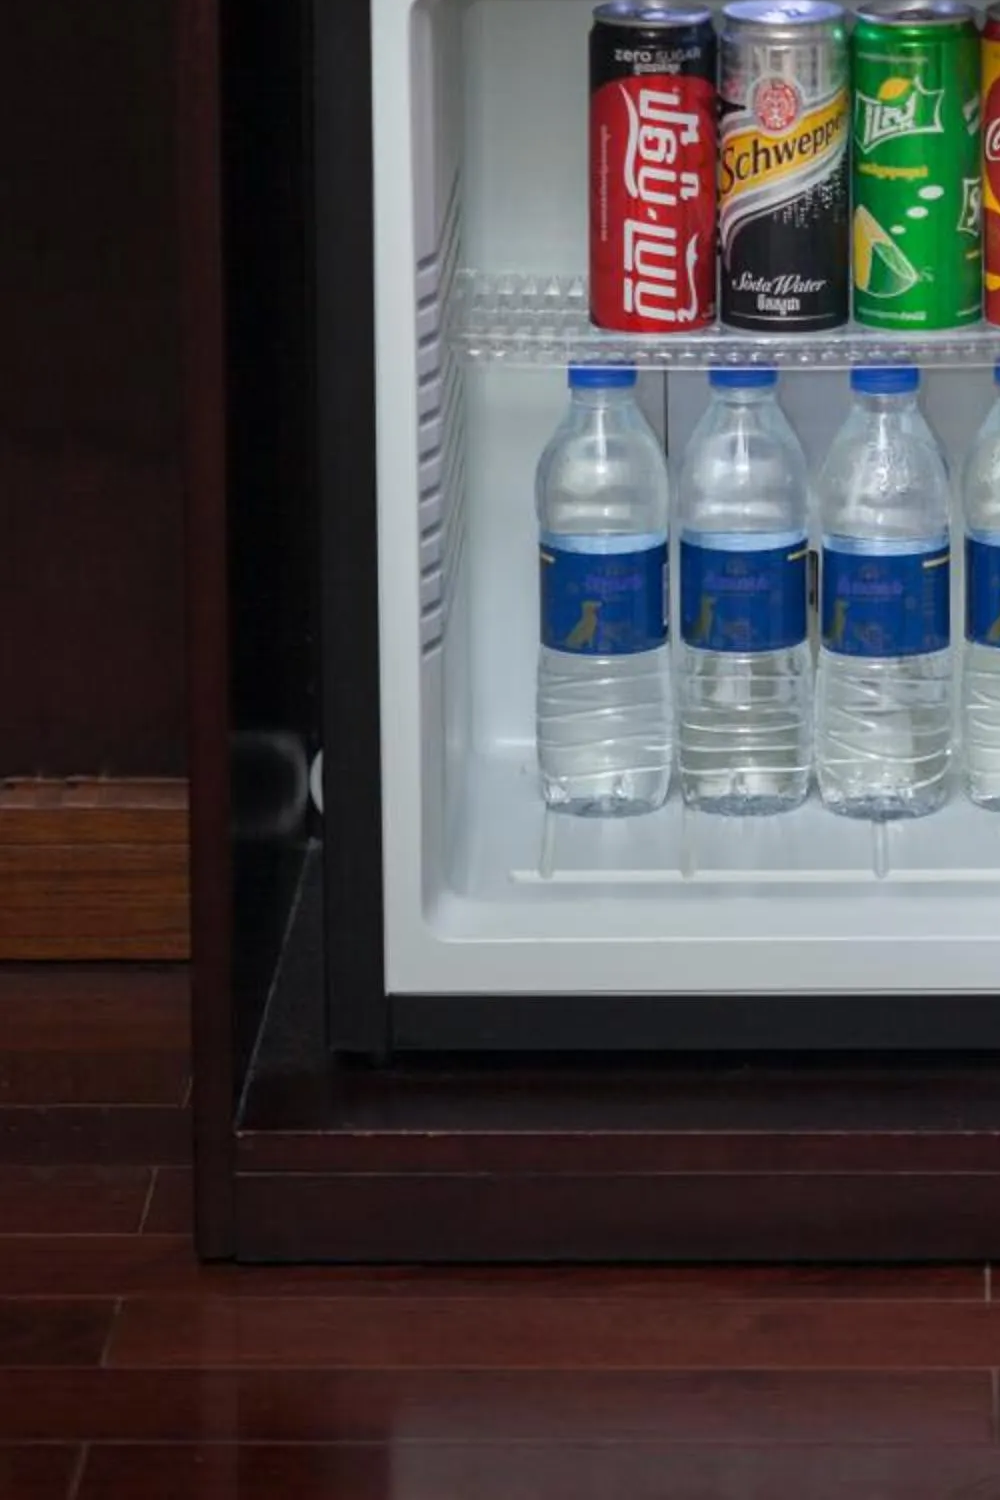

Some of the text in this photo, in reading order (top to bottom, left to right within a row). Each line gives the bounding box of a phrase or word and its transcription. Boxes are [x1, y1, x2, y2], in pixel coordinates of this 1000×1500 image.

[614, 48, 652, 63] zero
[731, 270, 828, 296] Soda Water
